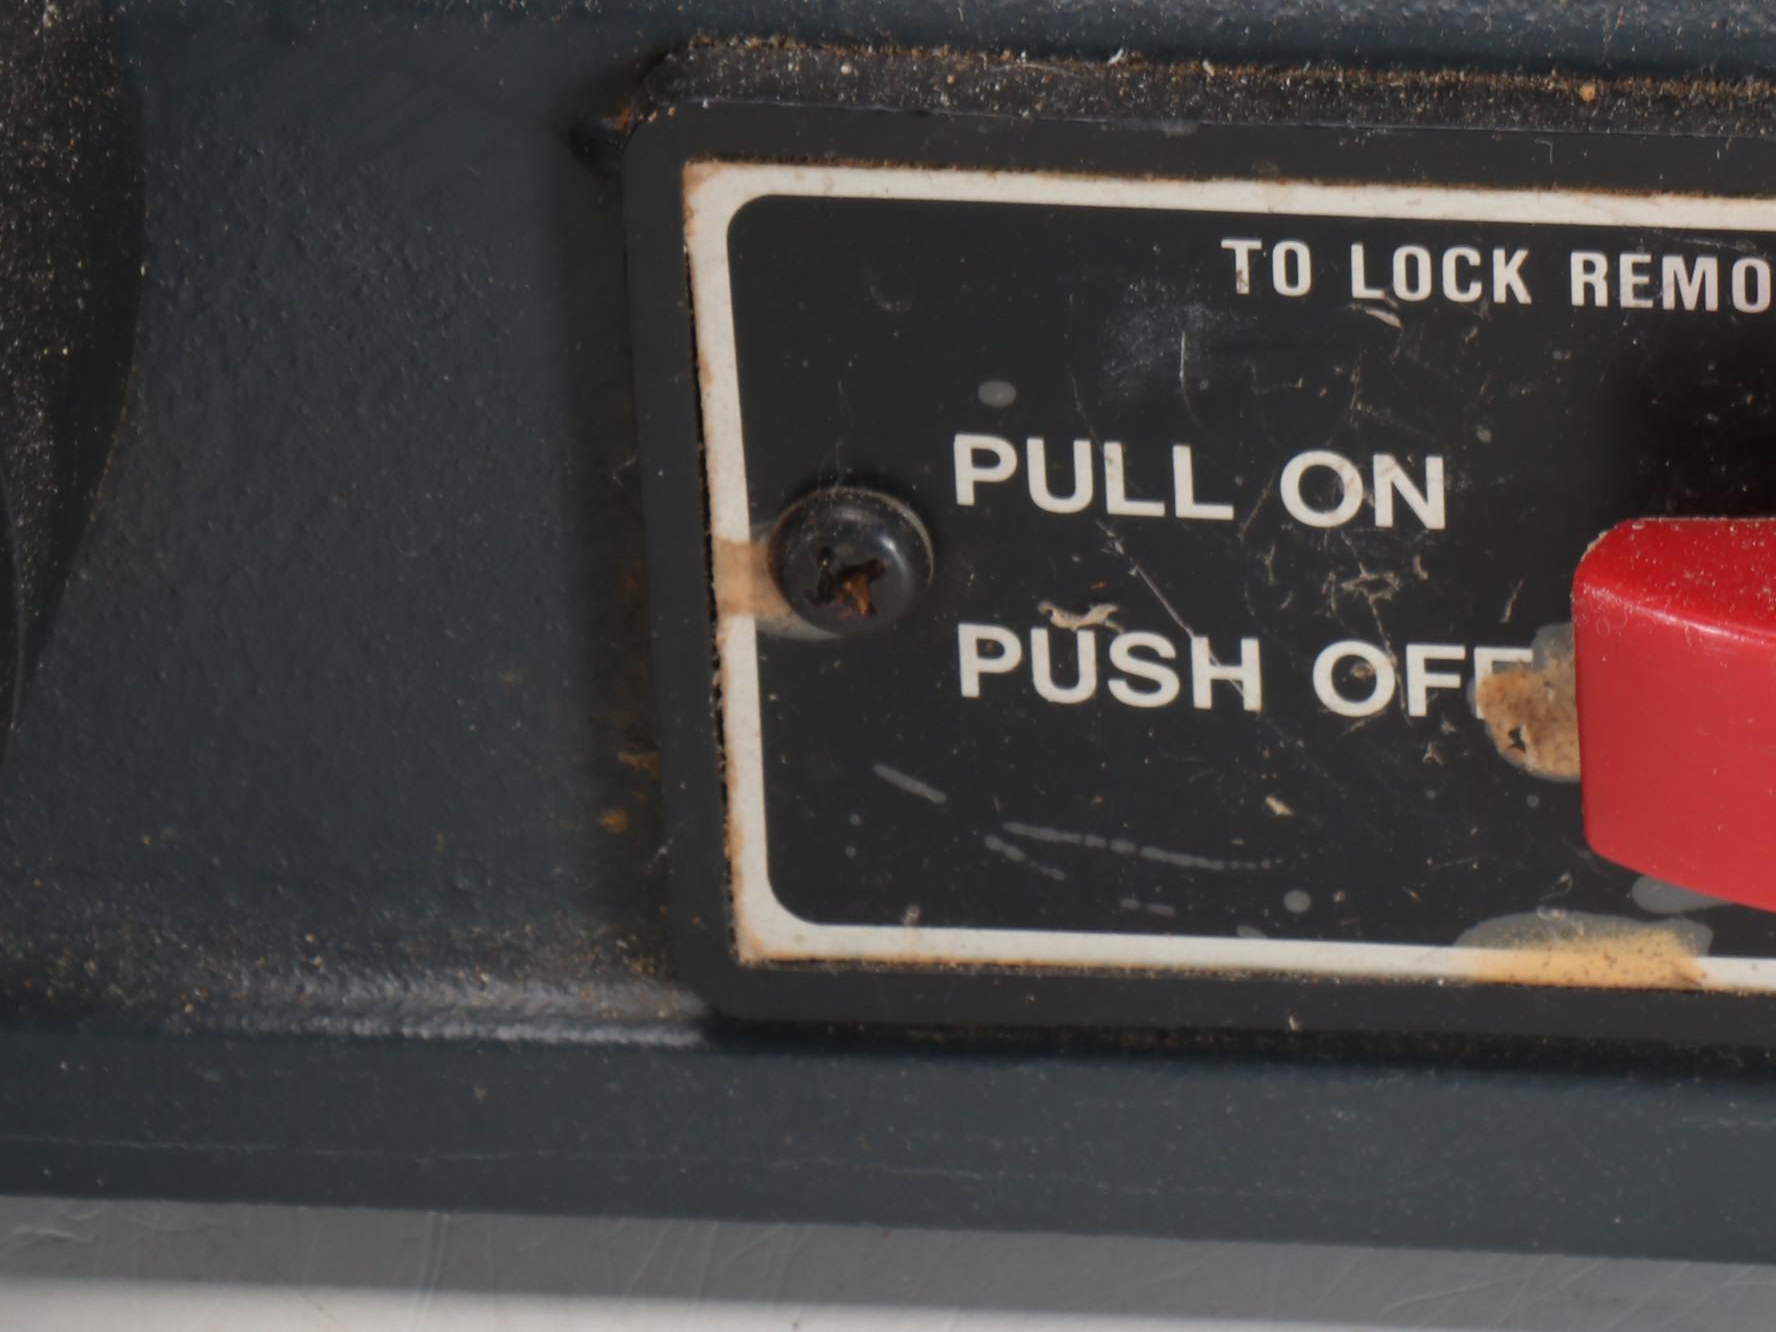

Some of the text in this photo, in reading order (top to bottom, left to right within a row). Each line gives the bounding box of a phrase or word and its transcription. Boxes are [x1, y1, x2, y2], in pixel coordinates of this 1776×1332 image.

[1221, 238, 1312, 297] TO
[1351, 243, 1532, 304] LOCK
[953, 434, 1446, 530] PULL ON
[958, 623, 1262, 711] PUSH
